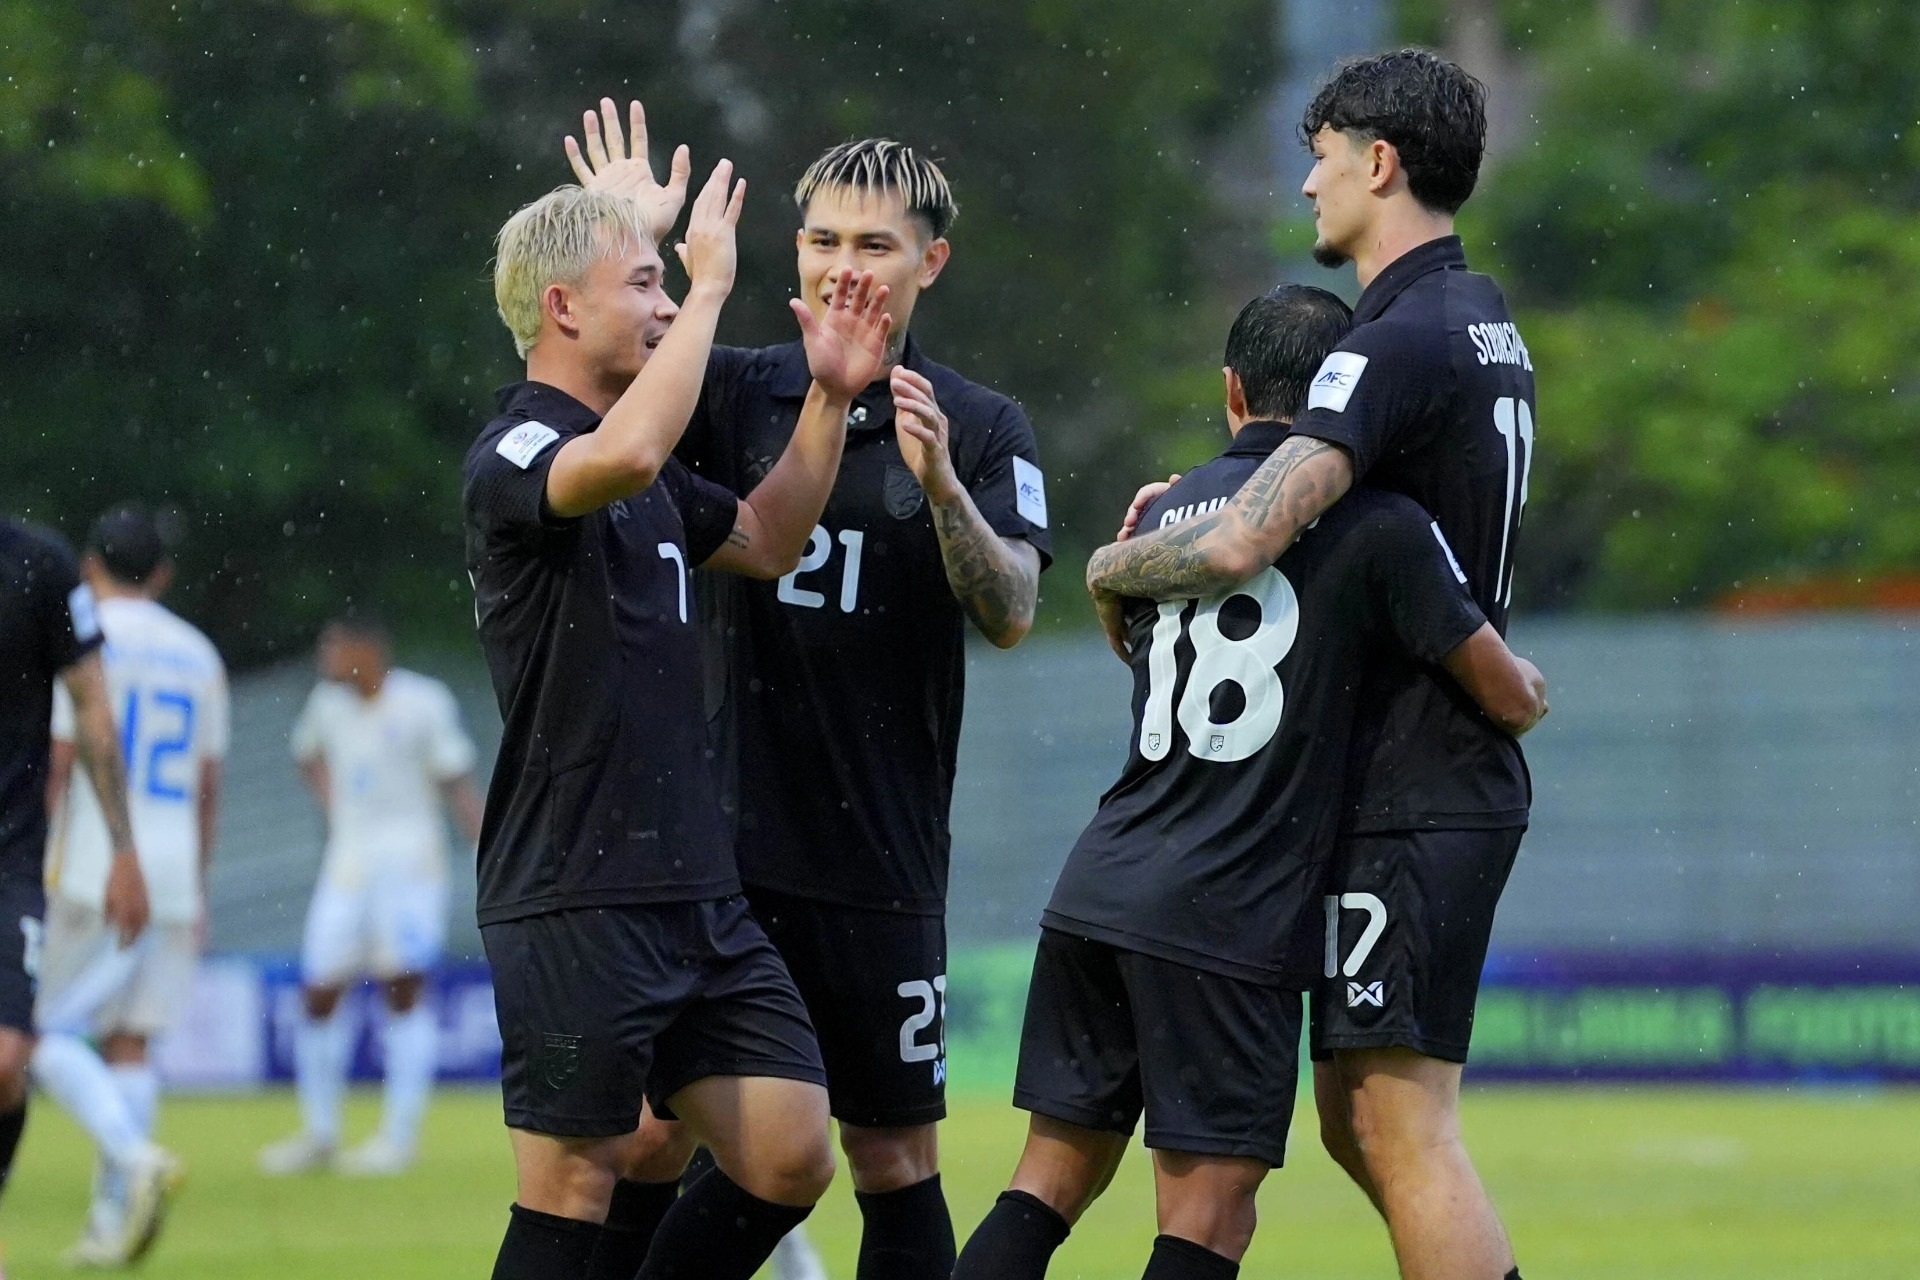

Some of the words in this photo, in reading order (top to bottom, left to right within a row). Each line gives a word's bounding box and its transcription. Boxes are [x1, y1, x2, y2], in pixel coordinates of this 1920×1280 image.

[1317, 371, 1352, 386] AFC
[1020, 482, 1040, 502] AFC
[777, 523, 864, 613] 21
[1139, 565, 1299, 763] 18
[121, 685, 195, 800] 12
[1323, 892, 1387, 978] 17
